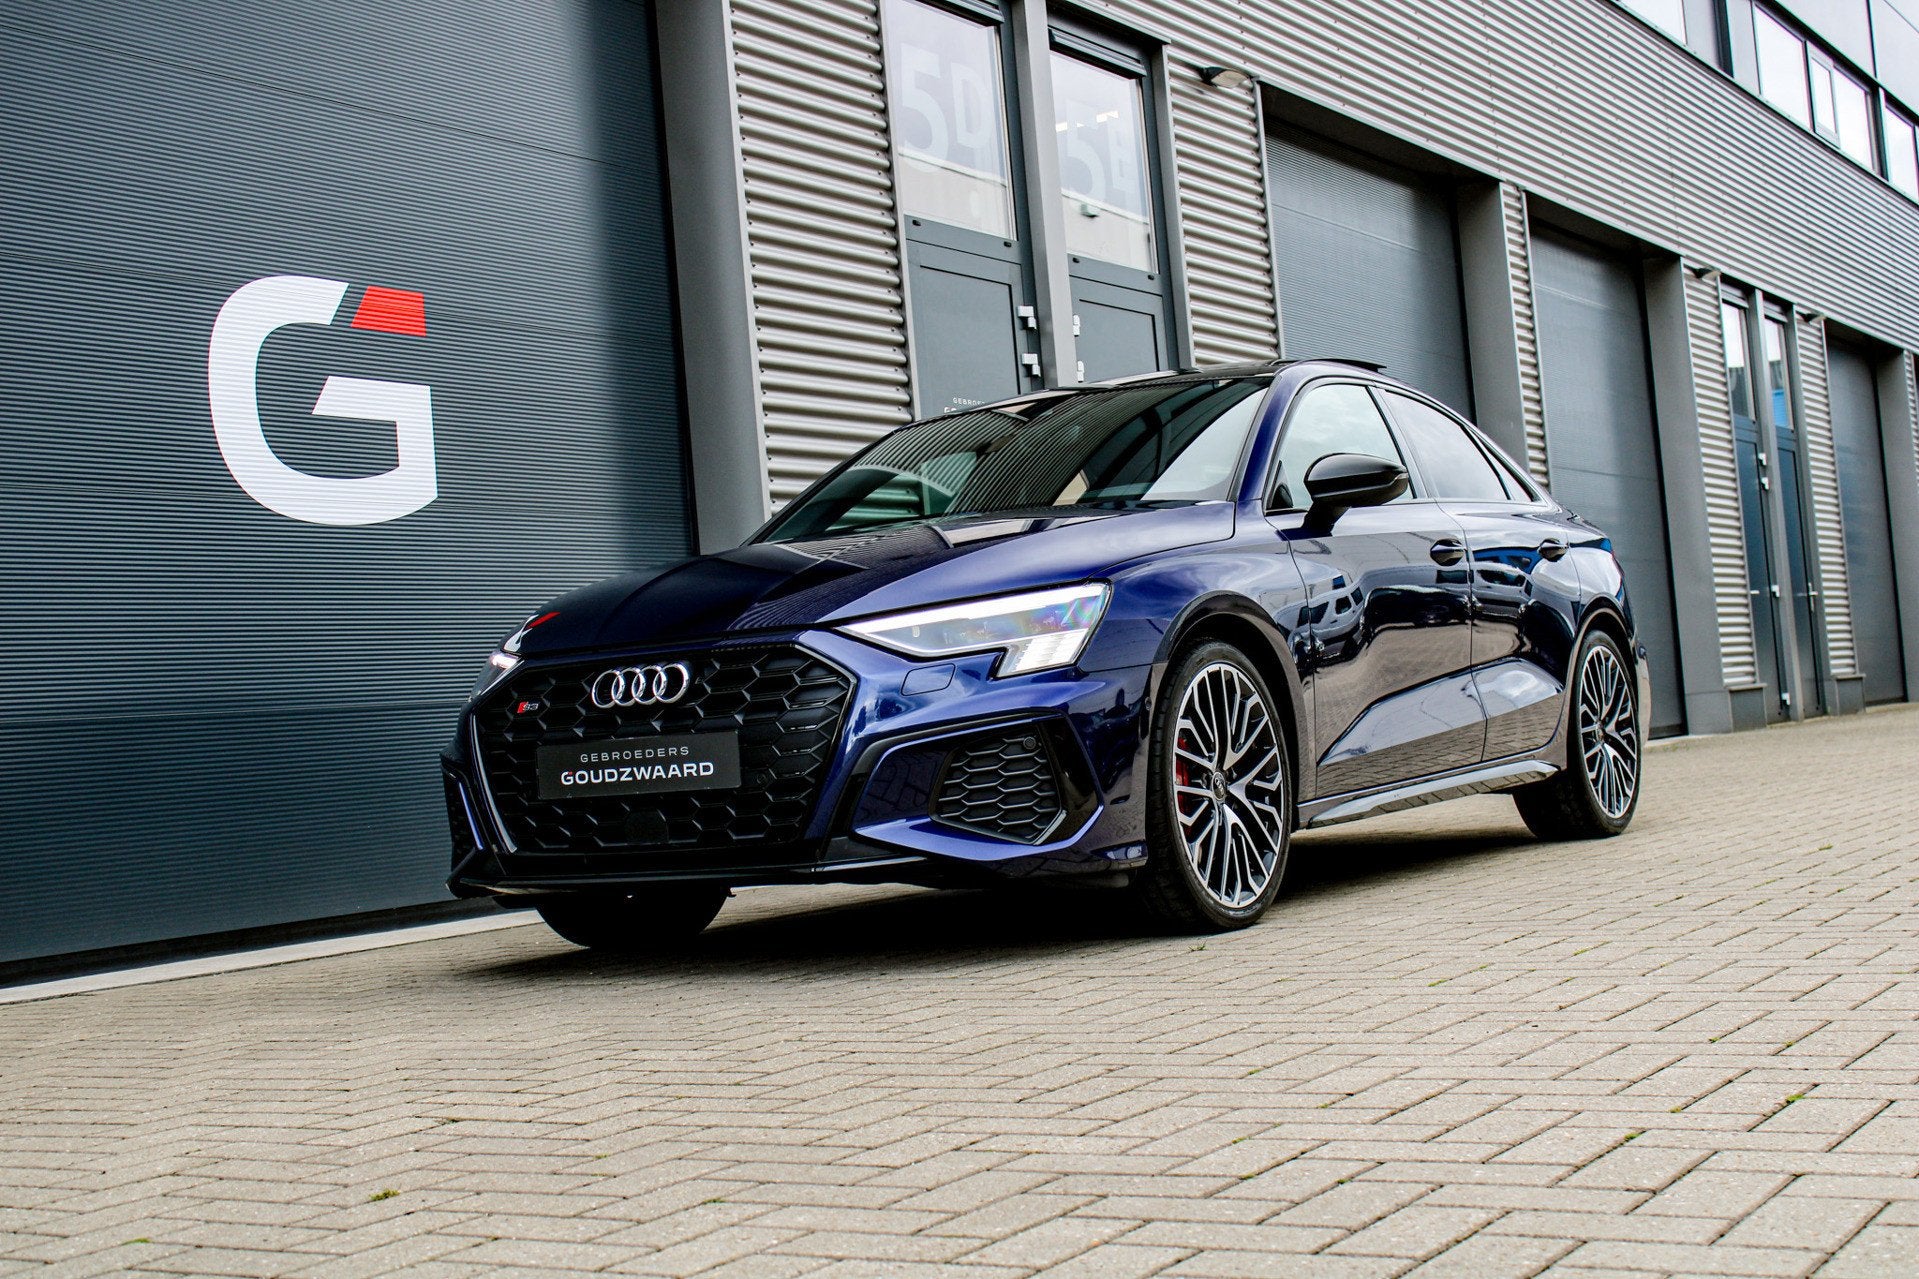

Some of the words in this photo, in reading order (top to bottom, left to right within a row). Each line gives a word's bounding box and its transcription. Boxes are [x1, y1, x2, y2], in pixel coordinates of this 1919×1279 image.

[898, 42, 992, 173] 5D
[580, 746, 689, 763] GEBROEDERS
[561, 762, 714, 785] GOUDZWAARD
